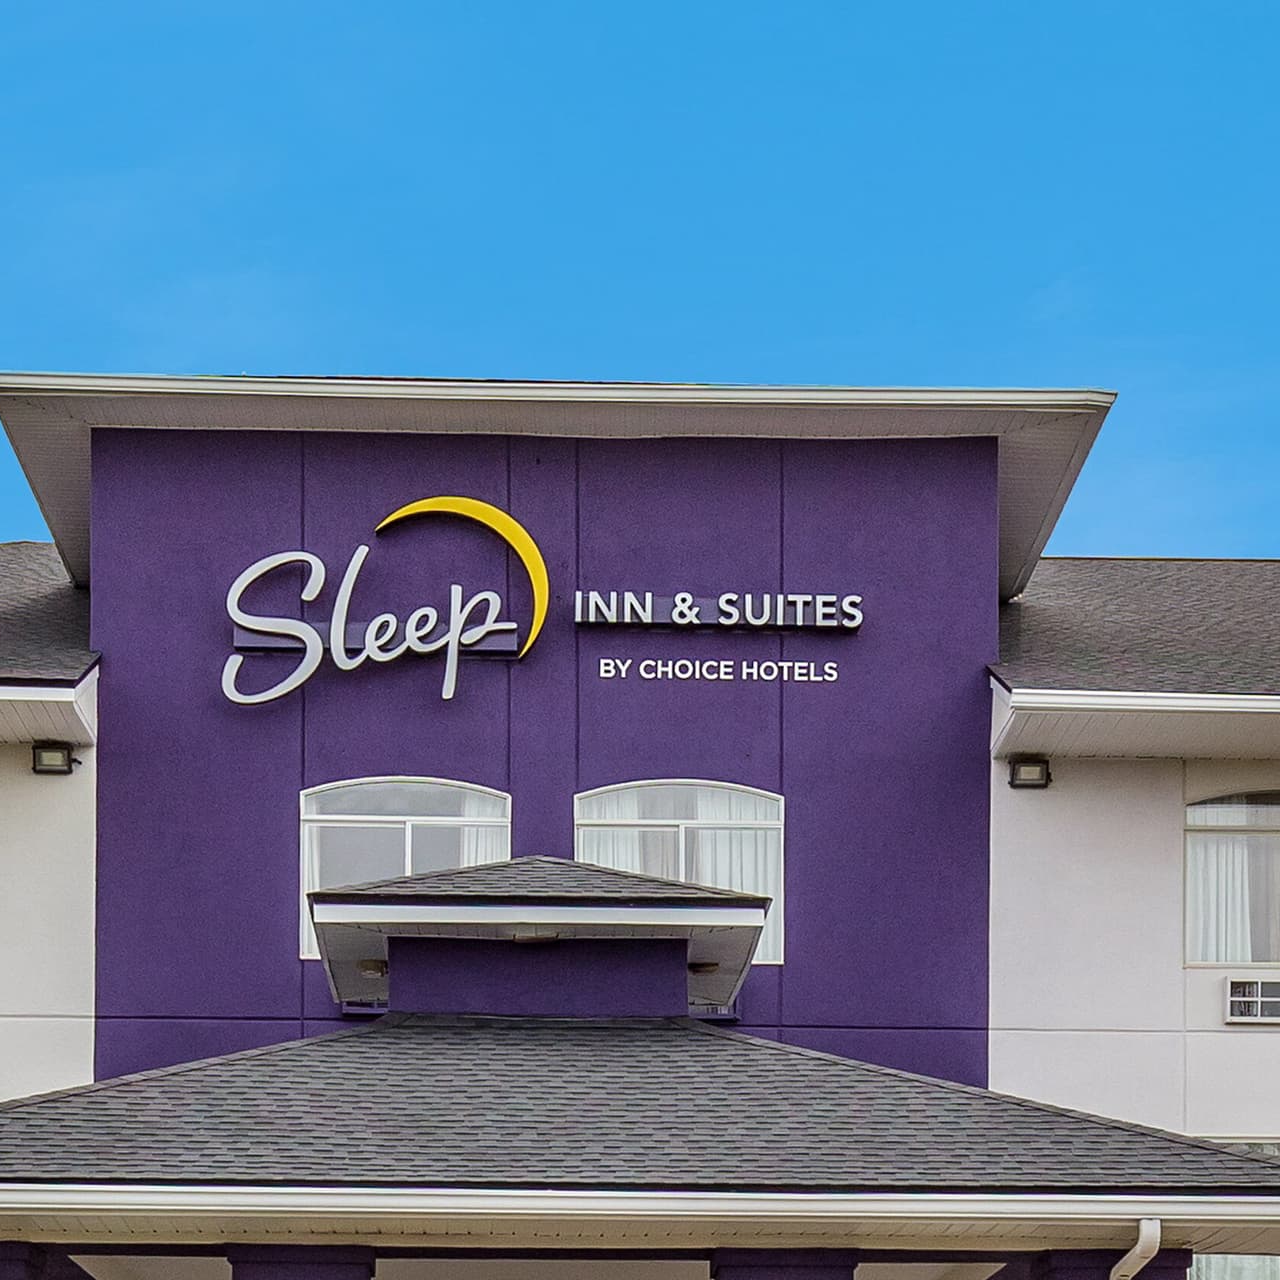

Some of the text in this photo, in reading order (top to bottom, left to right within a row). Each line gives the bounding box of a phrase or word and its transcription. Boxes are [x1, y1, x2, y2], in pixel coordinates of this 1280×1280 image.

[221, 544, 864, 704] Sleep INN & SUITES
[599, 658, 838, 682] BY CHOICE HOTELS
